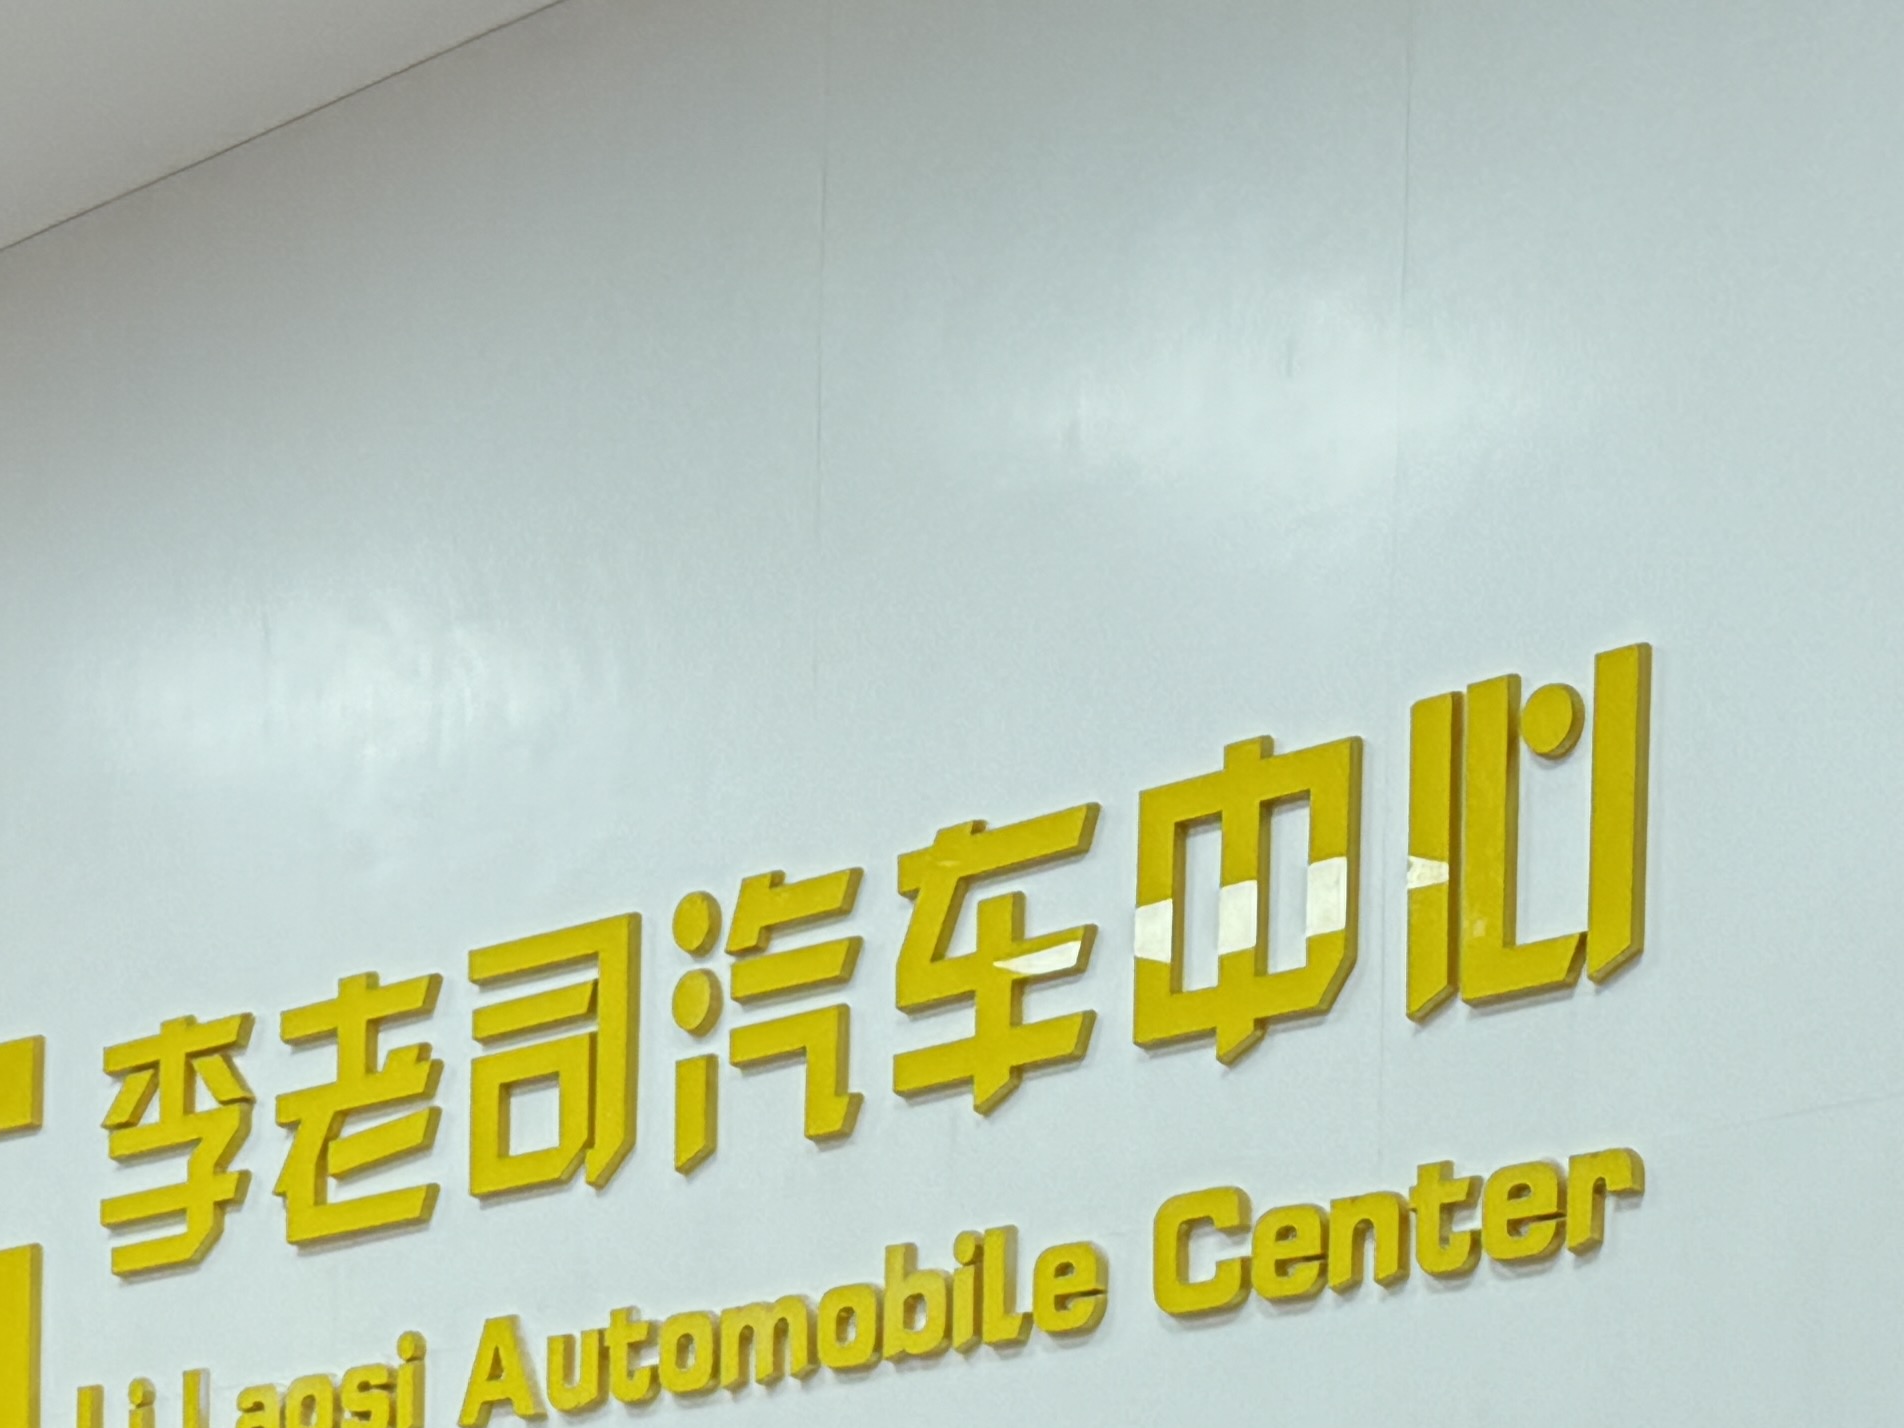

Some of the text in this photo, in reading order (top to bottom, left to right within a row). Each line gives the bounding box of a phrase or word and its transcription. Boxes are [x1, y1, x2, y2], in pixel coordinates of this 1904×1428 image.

[101, 645, 1652, 1277] 李老司汽车中心
[1153, 1150, 1645, 1317] Center
